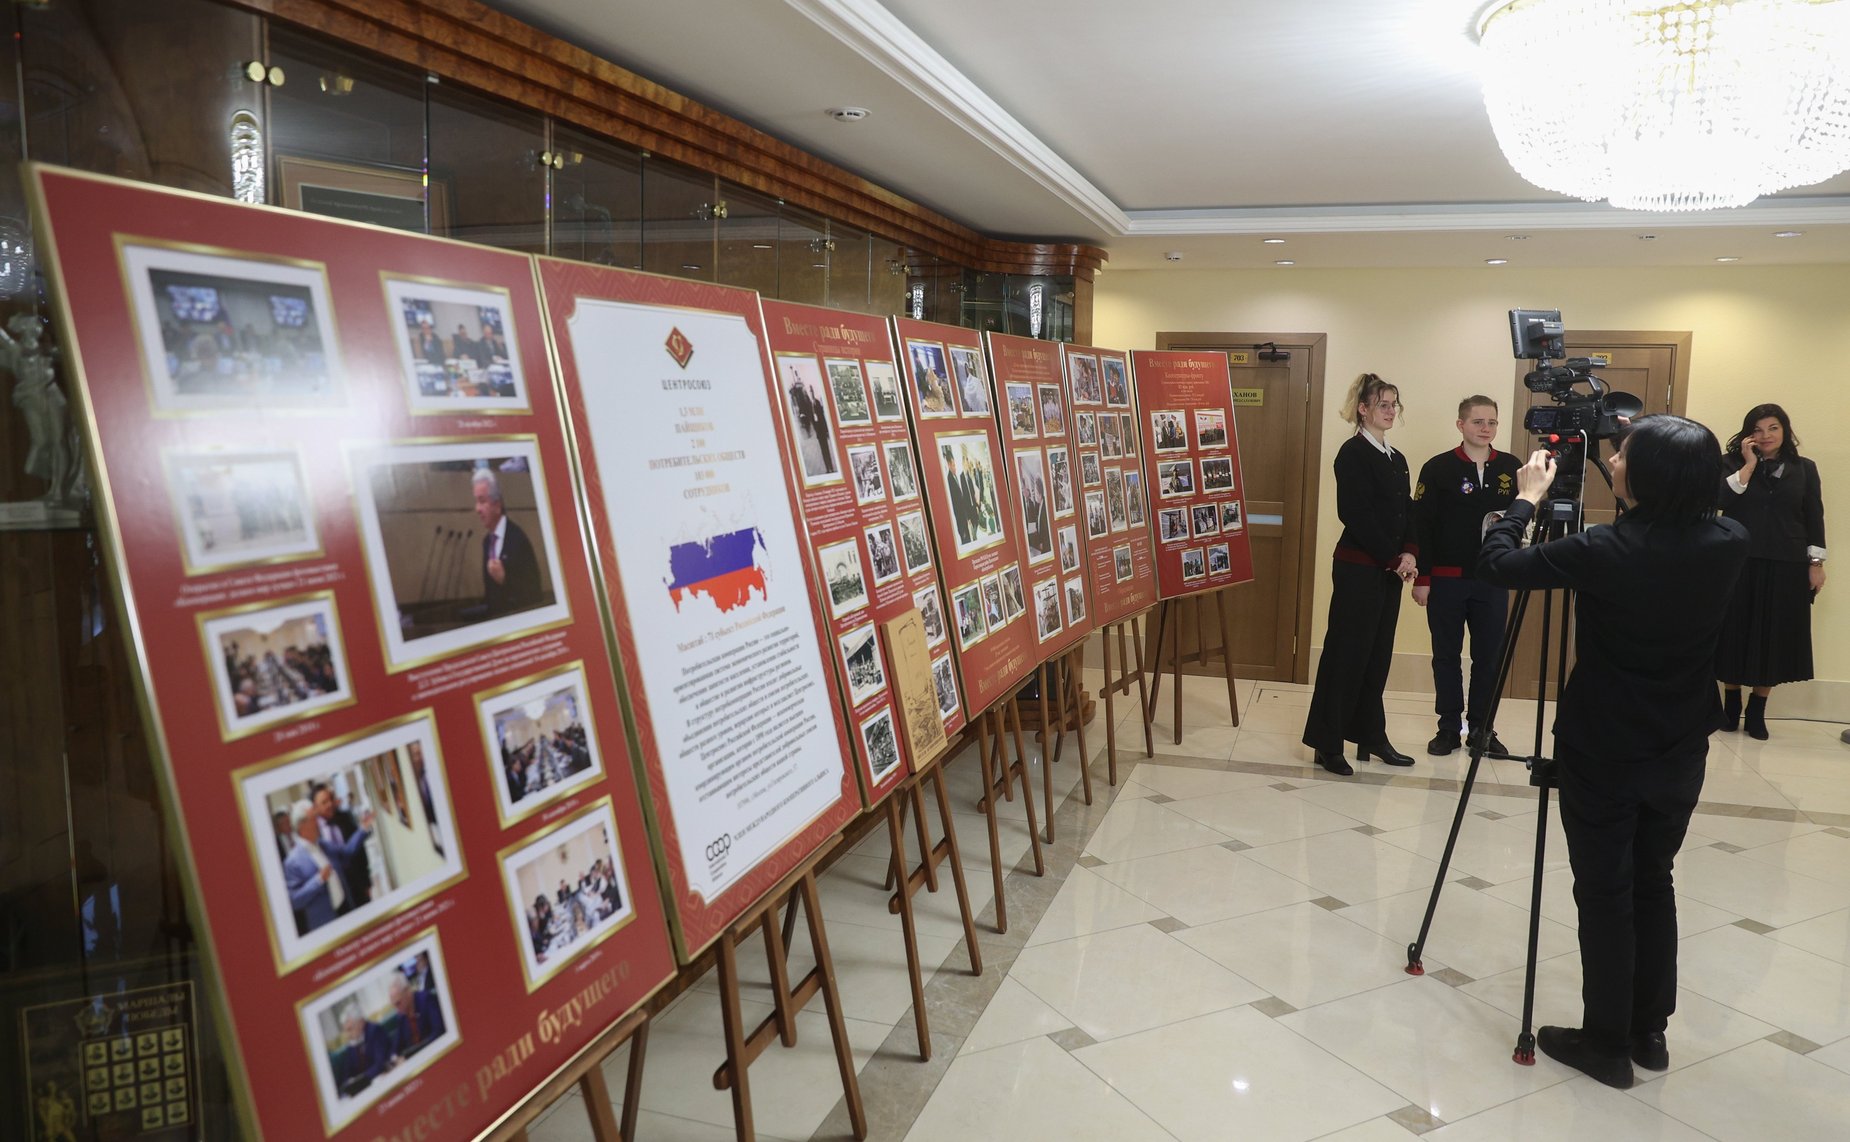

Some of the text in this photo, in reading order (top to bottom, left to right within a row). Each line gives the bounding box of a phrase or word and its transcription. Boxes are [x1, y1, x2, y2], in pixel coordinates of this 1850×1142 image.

[661, 379, 712, 391] ЦЕНТРОСОЮЗ
[371, 1082, 470, 1142] месте
[475, 1031, 536, 1103] ради
[536, 959, 631, 1044] будущего
